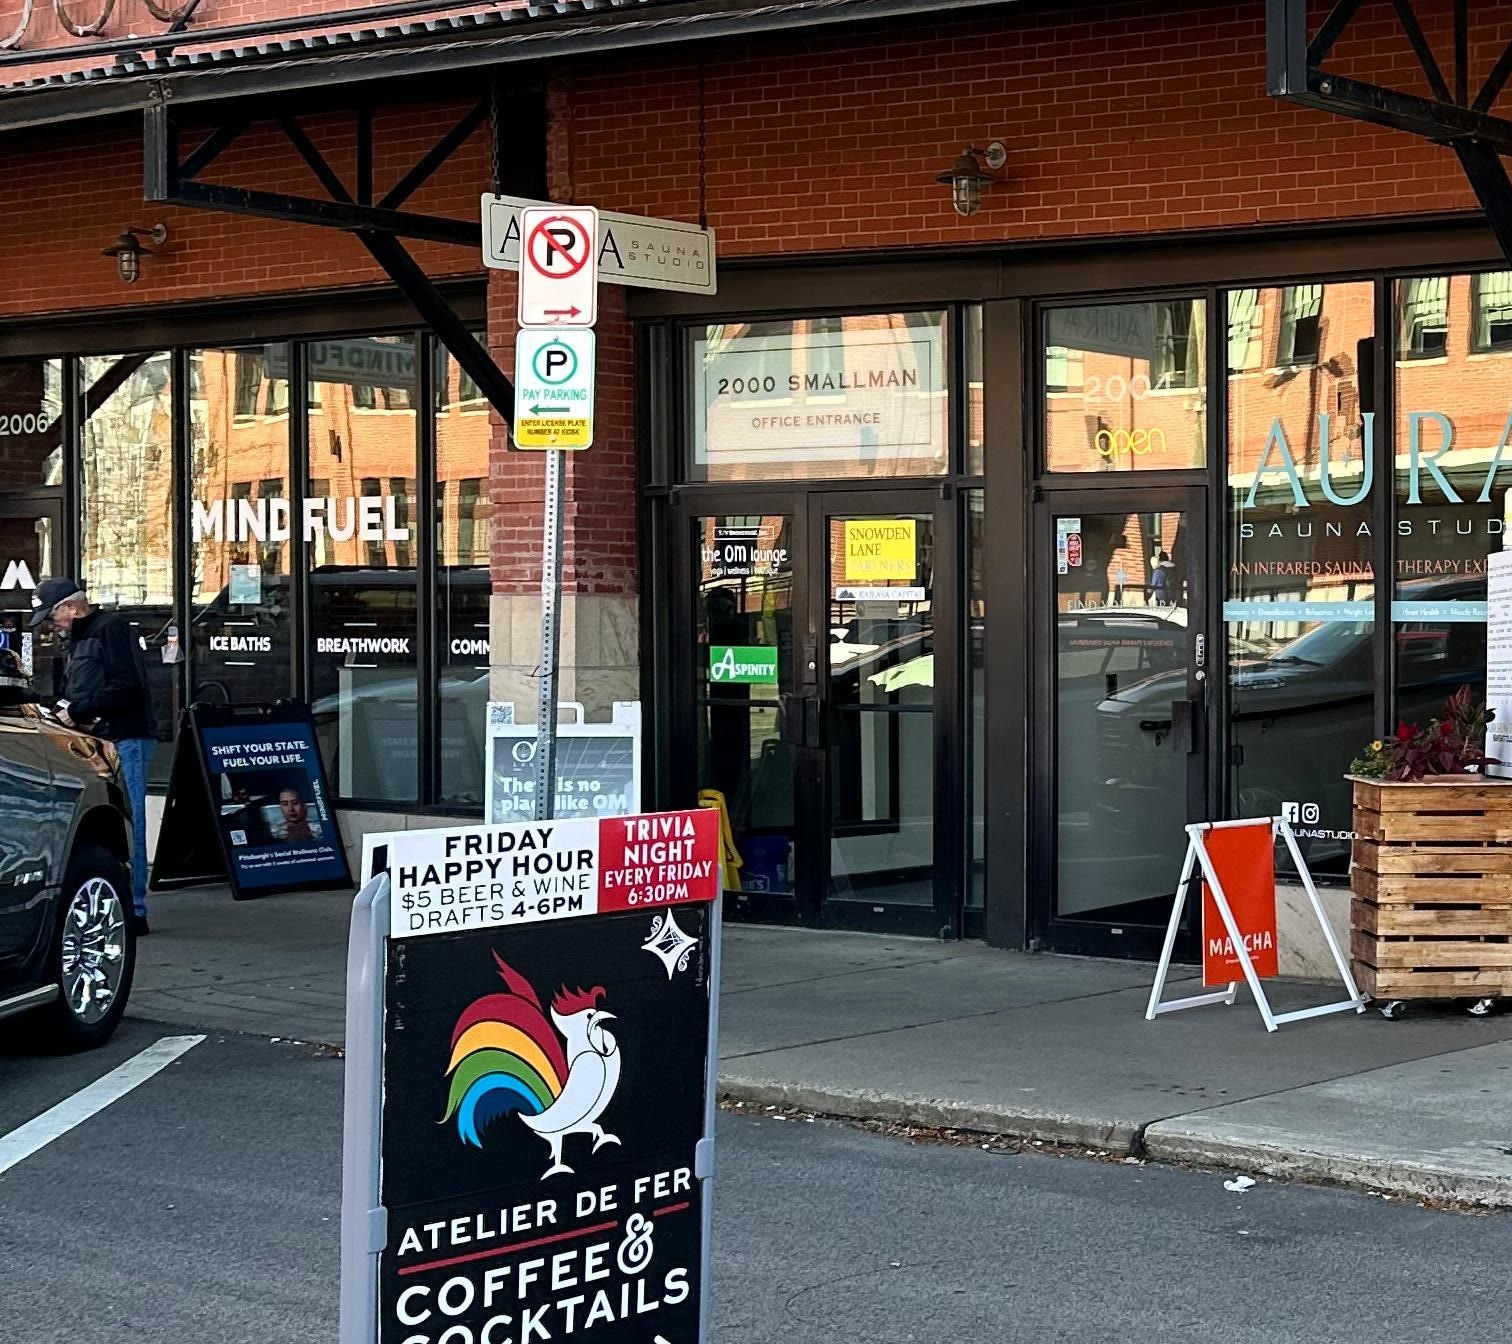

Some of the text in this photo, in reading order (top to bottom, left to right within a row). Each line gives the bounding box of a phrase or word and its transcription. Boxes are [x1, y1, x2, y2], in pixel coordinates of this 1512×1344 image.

[500, 214, 624, 269] AA
[631, 240, 700, 257] SAUNA
[628, 252, 704, 270] STUDIO
[718, 368, 917, 395] 2000 SMALLMAN
[1083, 373, 1172, 403] 2004
[523, 388, 587, 401] PAY PARKING
[0, 412, 48, 436] 2006
[751, 412, 881, 430] OFFICE ENTRANCE
[1094, 427, 1167, 464] open
[192, 495, 409, 543] MINDFUEL
[1240, 520, 1372, 538] SAUNA
[849, 526, 911, 541] SNOWDEN
[701, 547, 721, 563] the
[750, 546, 788, 567] lounge
[850, 543, 882, 557] LANE
[1230, 560, 1249, 576] AN
[1254, 560, 1321, 576] INFRARED
[1325, 560, 1374, 576] SAUNA
[1397, 559, 1461, 574] THERAPY
[209, 636, 271, 652] ICE BATHS
[316, 638, 410, 653] BREATHWORK
[711, 647, 776, 681] ASPINITY
[211, 744, 241, 756] SHIFT
[243, 742, 273, 753] YOUR
[222, 757, 249, 768] FUEL
[249, 755, 280, 766] YOUR
[500, 776, 601, 793] The is no
[500, 794, 627, 814] pla like OM
[623, 815, 696, 843] TRIVIA
[445, 828, 554, 858] FRIDAY
[623, 838, 696, 867] NIGHT
[399, 849, 595, 888] HAPPY HOUR
[604, 860, 713, 888] EVERY FRIDAY
[402, 873, 591, 912] $5 BEER & WINE
[627, 882, 689, 905] 6:30PM
[409, 895, 583, 931] DRAFTS 4-6PM
[1209, 930, 1273, 957] MACHA
[397, 1167, 691, 1256] ATELIER DE FER
[396, 1212, 654, 1326] COFFEE &
